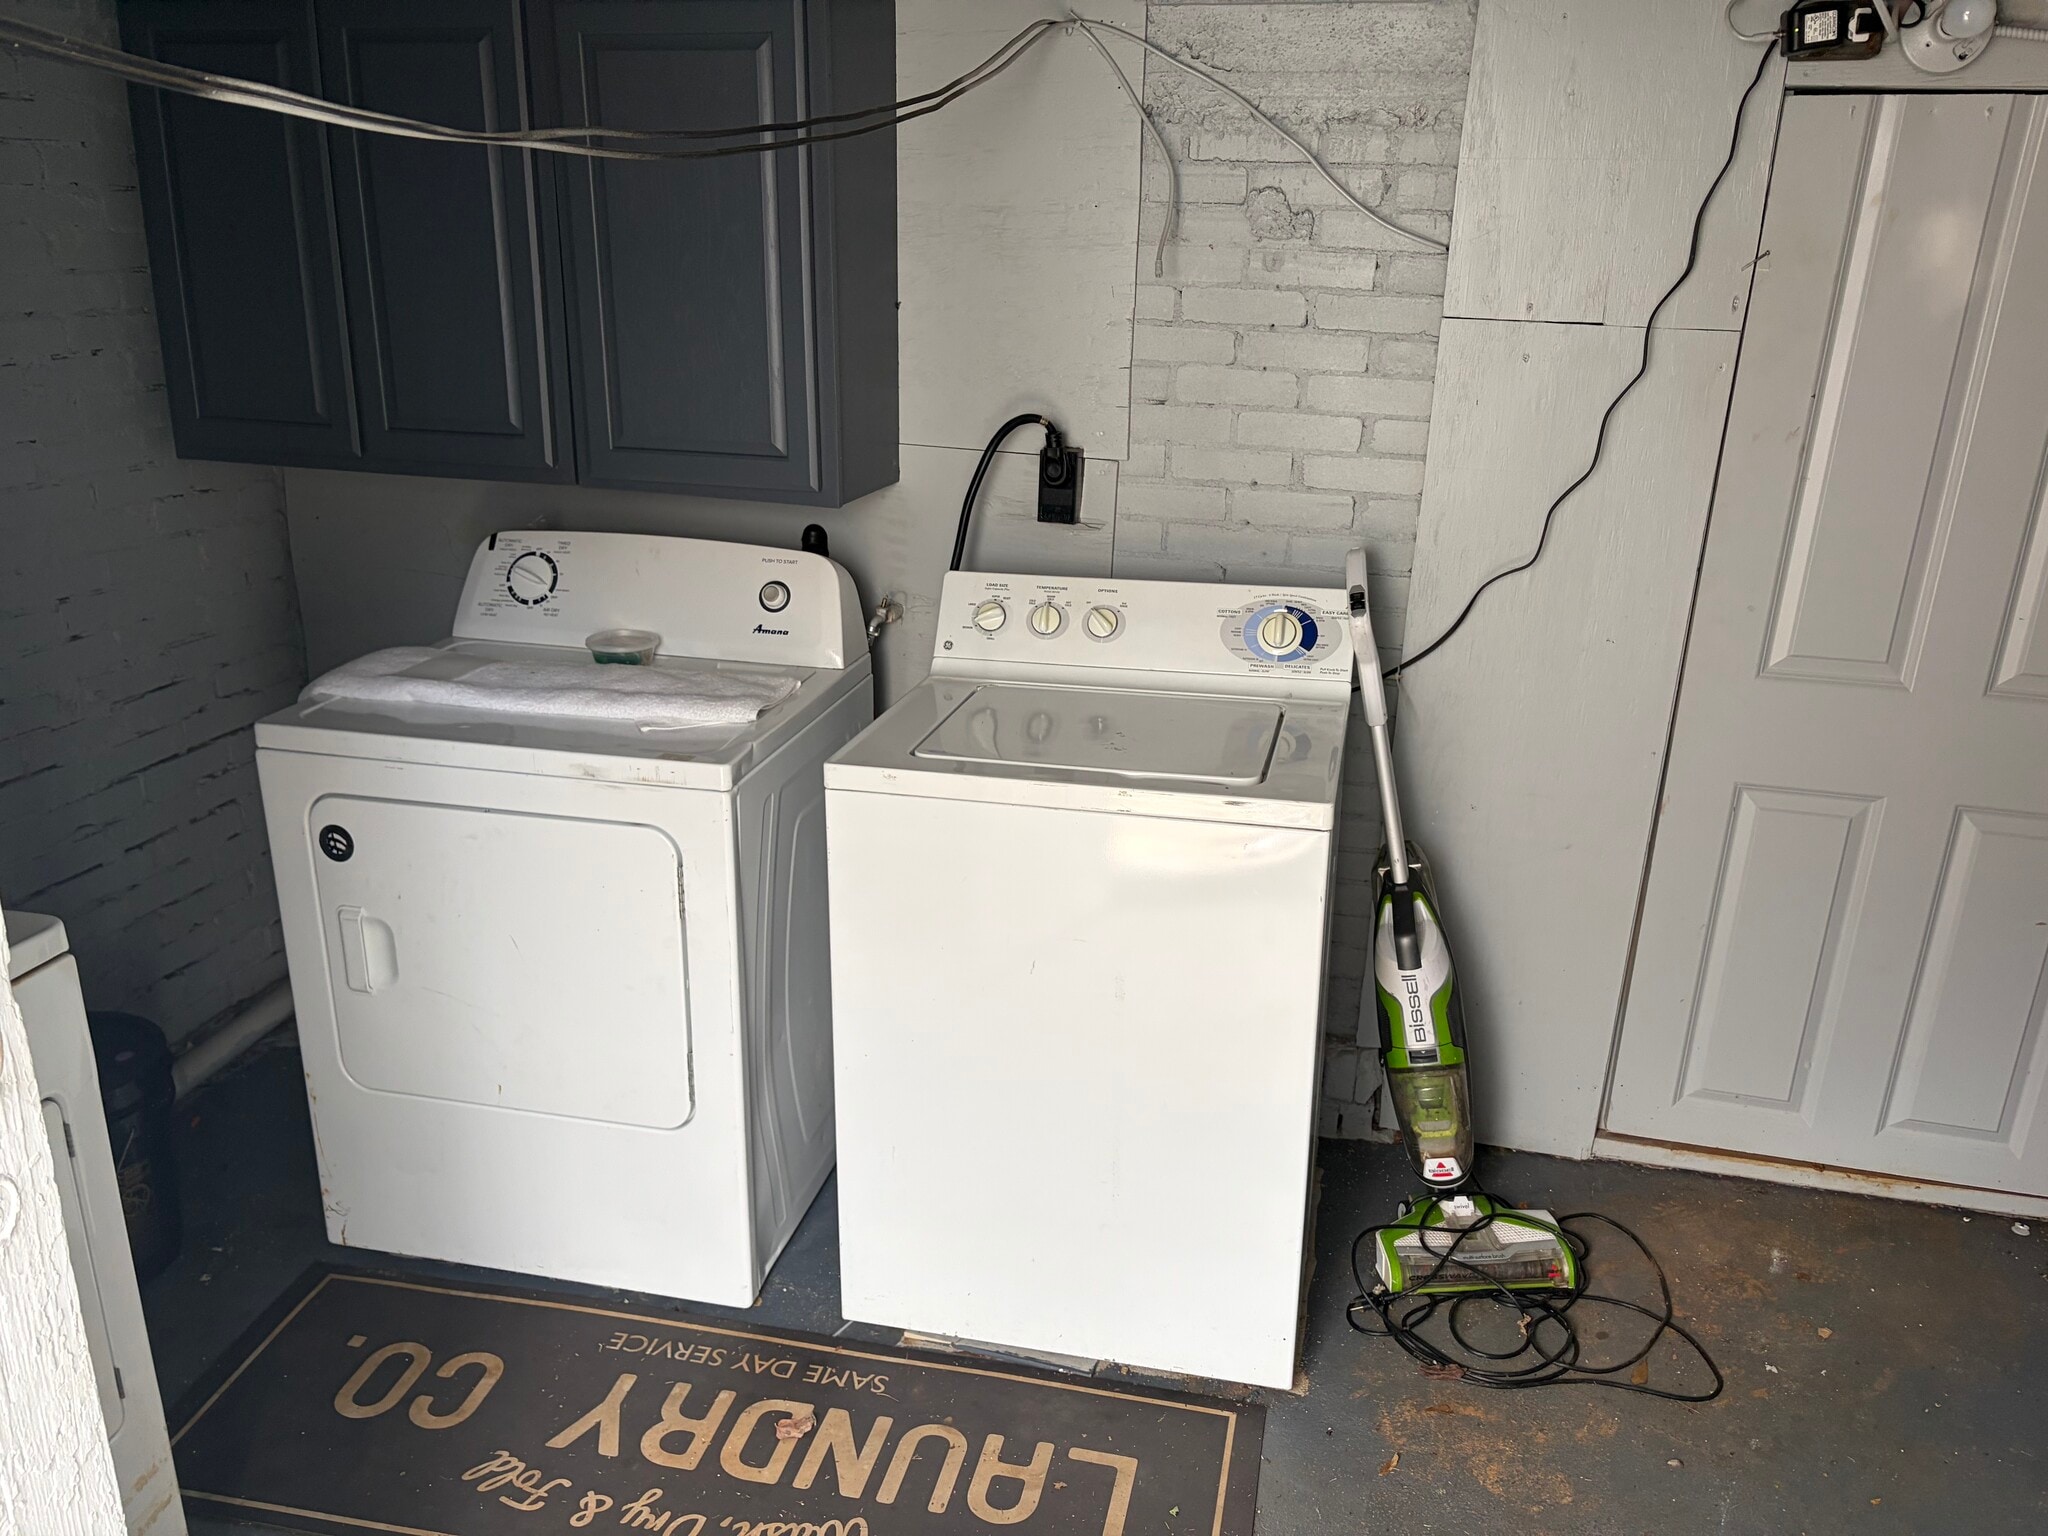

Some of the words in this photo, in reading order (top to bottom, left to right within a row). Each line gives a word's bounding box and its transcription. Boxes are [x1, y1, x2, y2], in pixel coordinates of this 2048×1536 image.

[752, 624, 789, 635] Amana
[609, 1332, 727, 1367] SERVICE
[730, 1354, 798, 1379] DAY
[334, 1335, 504, 1429] CO.
[801, 1364, 889, 1394] SAME
[545, 1373, 1138, 1536] LAUNDRY
[462, 1450, 571, 1511] Fold
[570, 1490, 613, 1527] &
[620, 1488, 707, 1536] Dry
